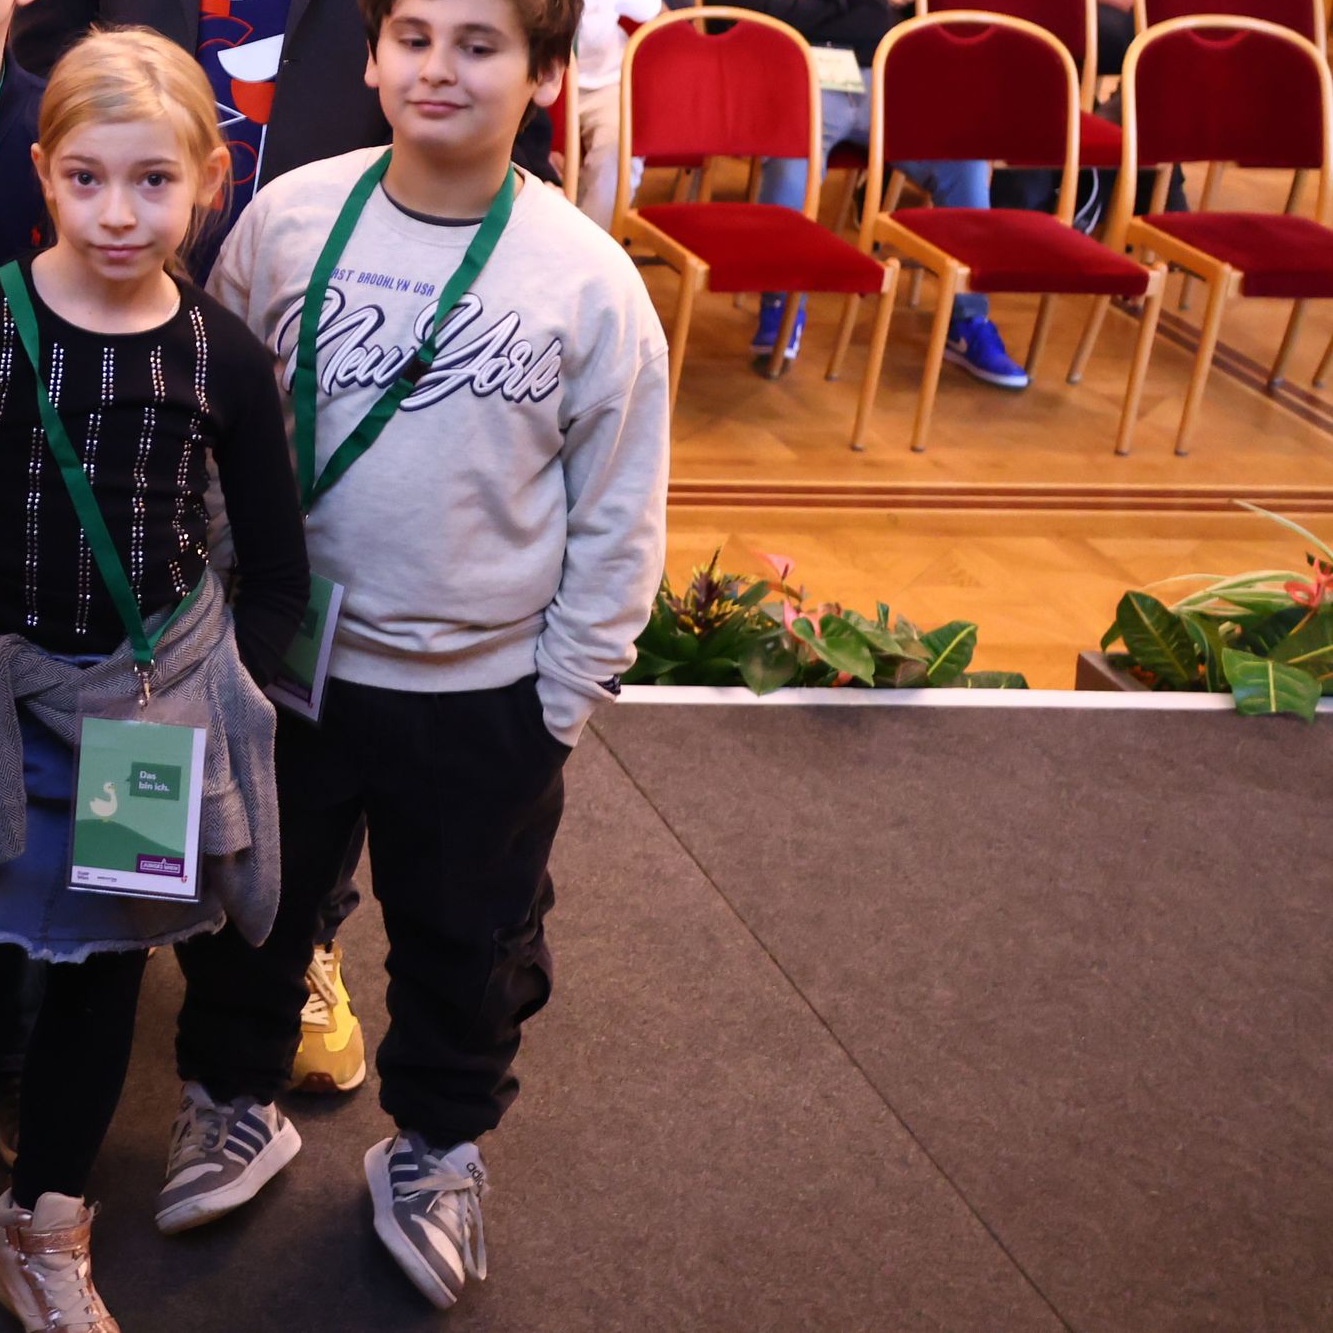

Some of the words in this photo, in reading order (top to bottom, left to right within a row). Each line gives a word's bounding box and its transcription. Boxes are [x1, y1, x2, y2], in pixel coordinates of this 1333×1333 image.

[413, 281, 435, 297] USA
[275, 284, 417, 397] New
[399, 292, 563, 412] York
